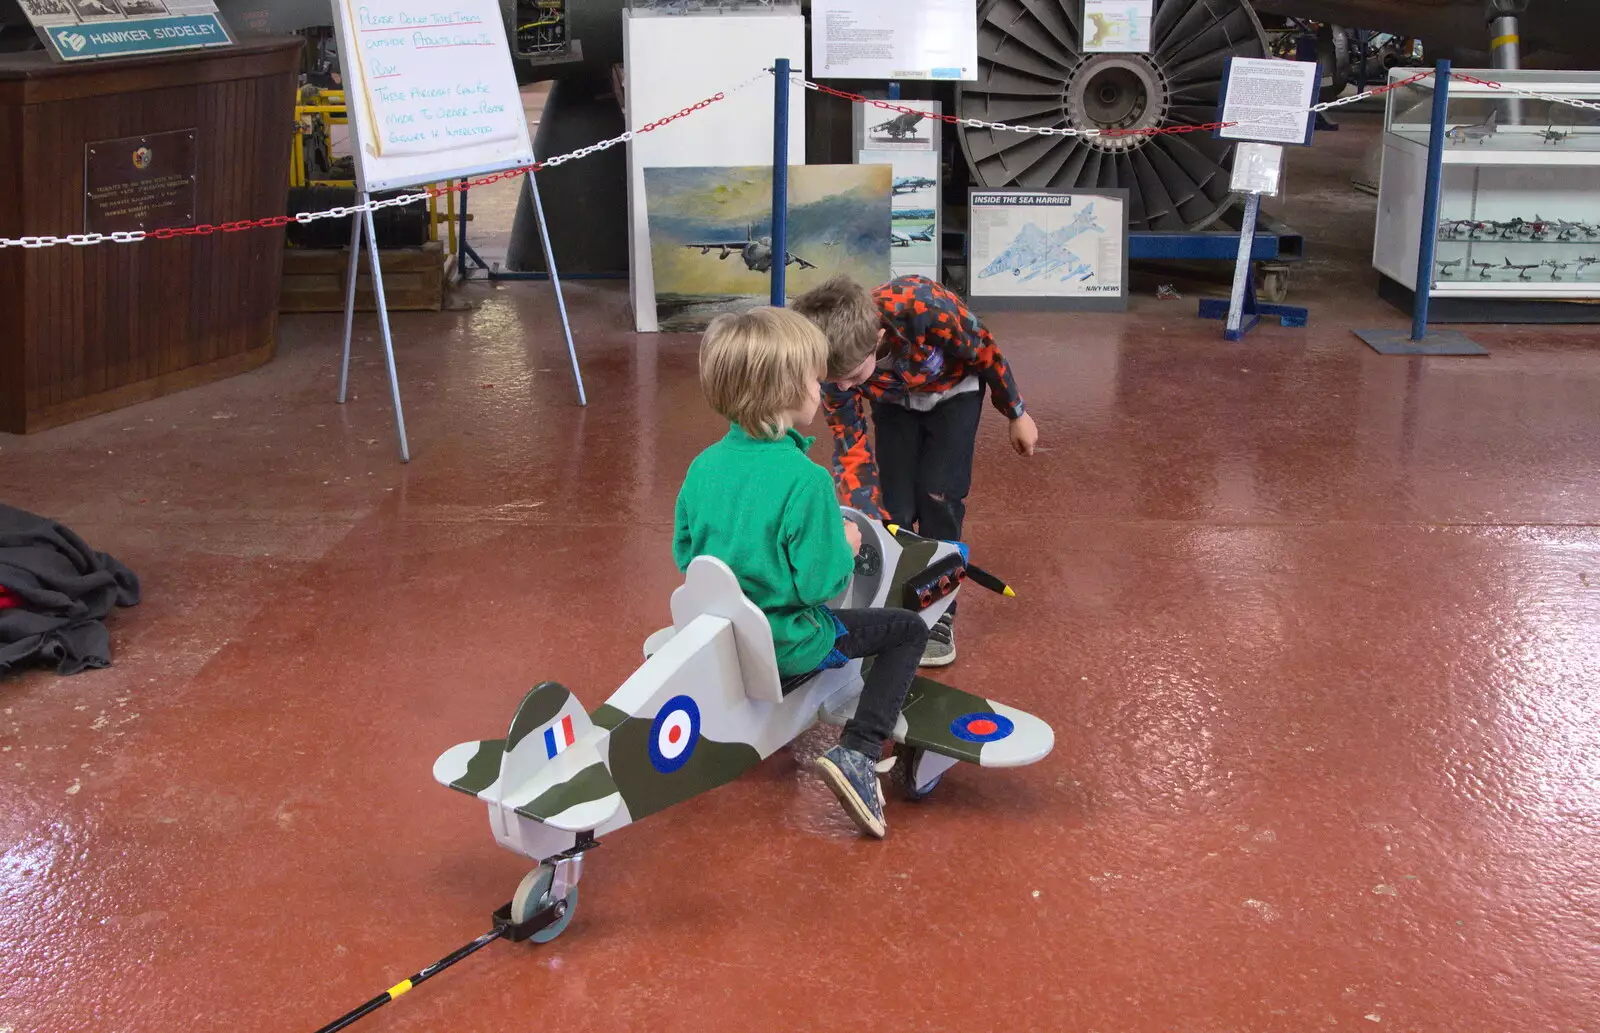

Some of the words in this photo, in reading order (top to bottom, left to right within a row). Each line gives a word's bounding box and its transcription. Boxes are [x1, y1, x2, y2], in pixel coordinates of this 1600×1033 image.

[359, 6, 393, 25] PLEASE
[90, 30, 151, 45] HAWKER
[154, 24, 216, 39] SIDDELEY
[974, 196, 1001, 204] INSIDE
[1003, 196, 1017, 204] THE
[1018, 196, 1034, 204] SEA
[1036, 196, 1070, 204] HARRIER
